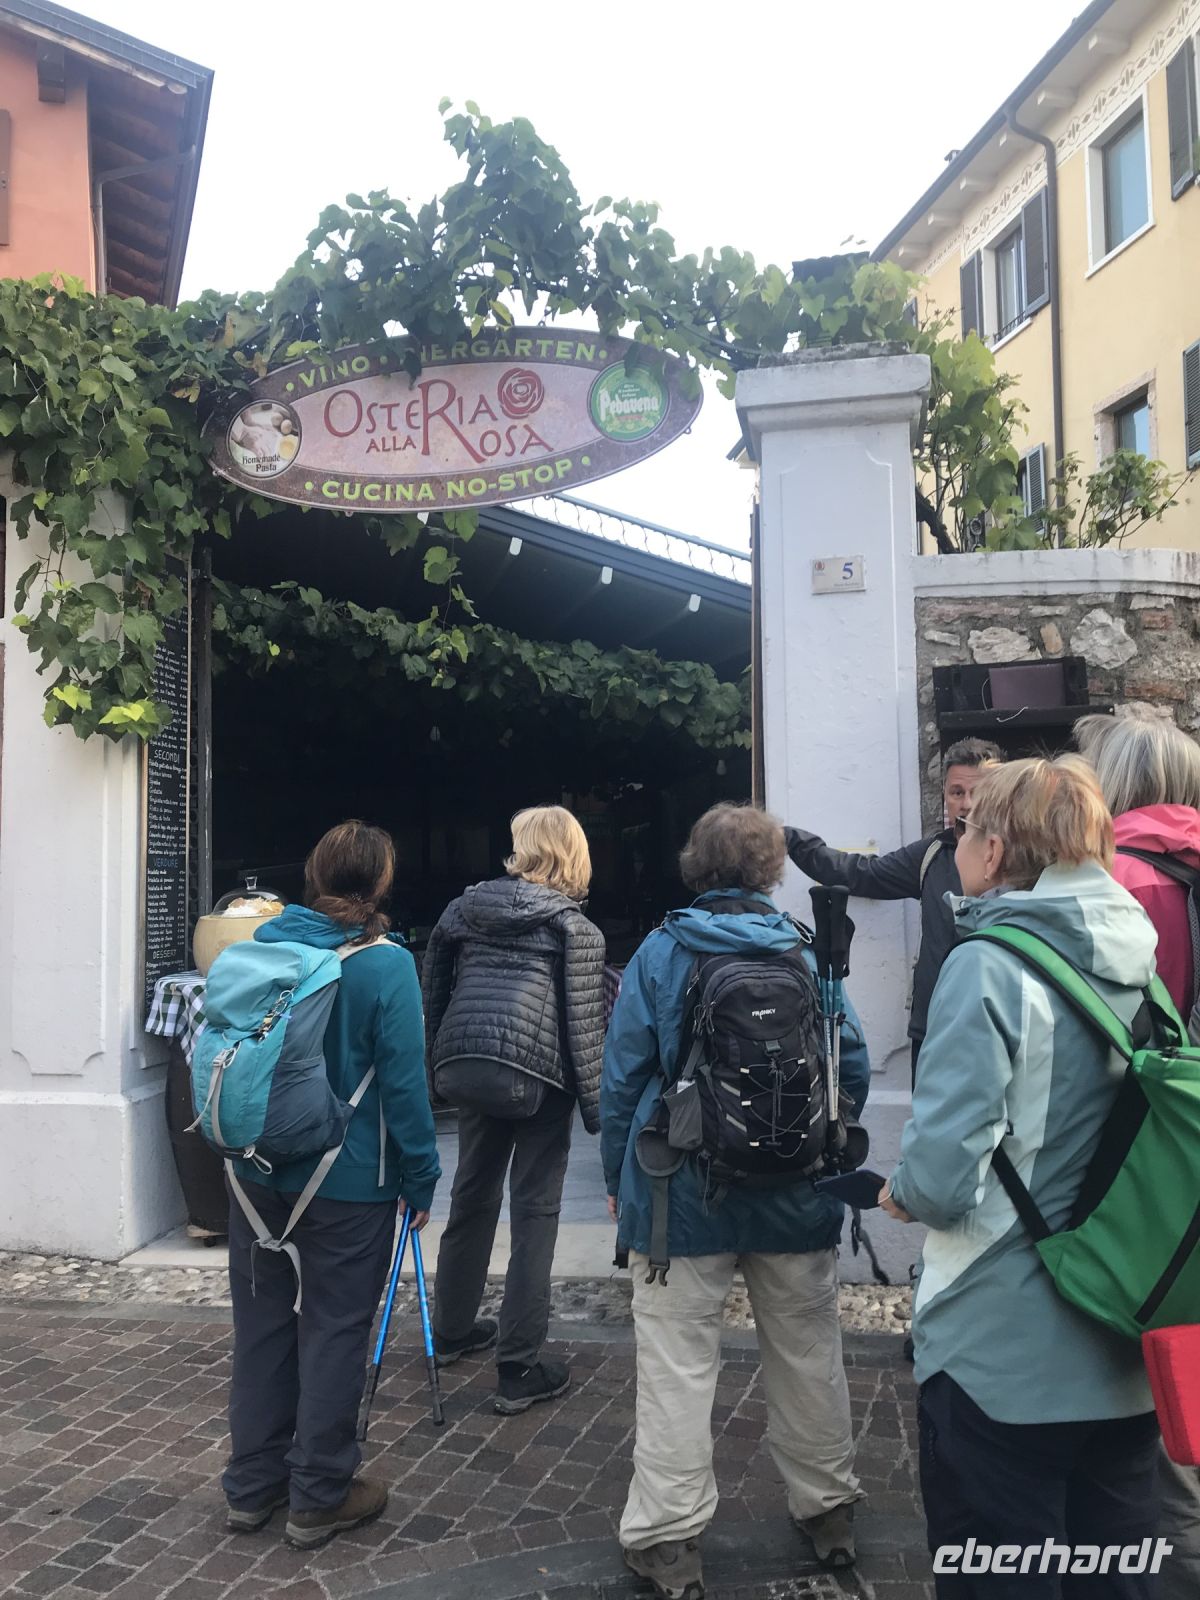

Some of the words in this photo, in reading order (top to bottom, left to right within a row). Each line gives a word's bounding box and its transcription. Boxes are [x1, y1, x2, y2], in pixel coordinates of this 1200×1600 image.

[299, 355, 370, 388] VINO
[366, 435, 417, 454] ALLA
[242, 453, 281, 465] Homemade
[256, 463, 277, 473] Pasta
[322, 480, 436, 501] CUCINA
[446, 458, 573, 499] NO-STOP
[842, 561, 854, 580] 5
[153, 749, 180, 764] SECONDI
